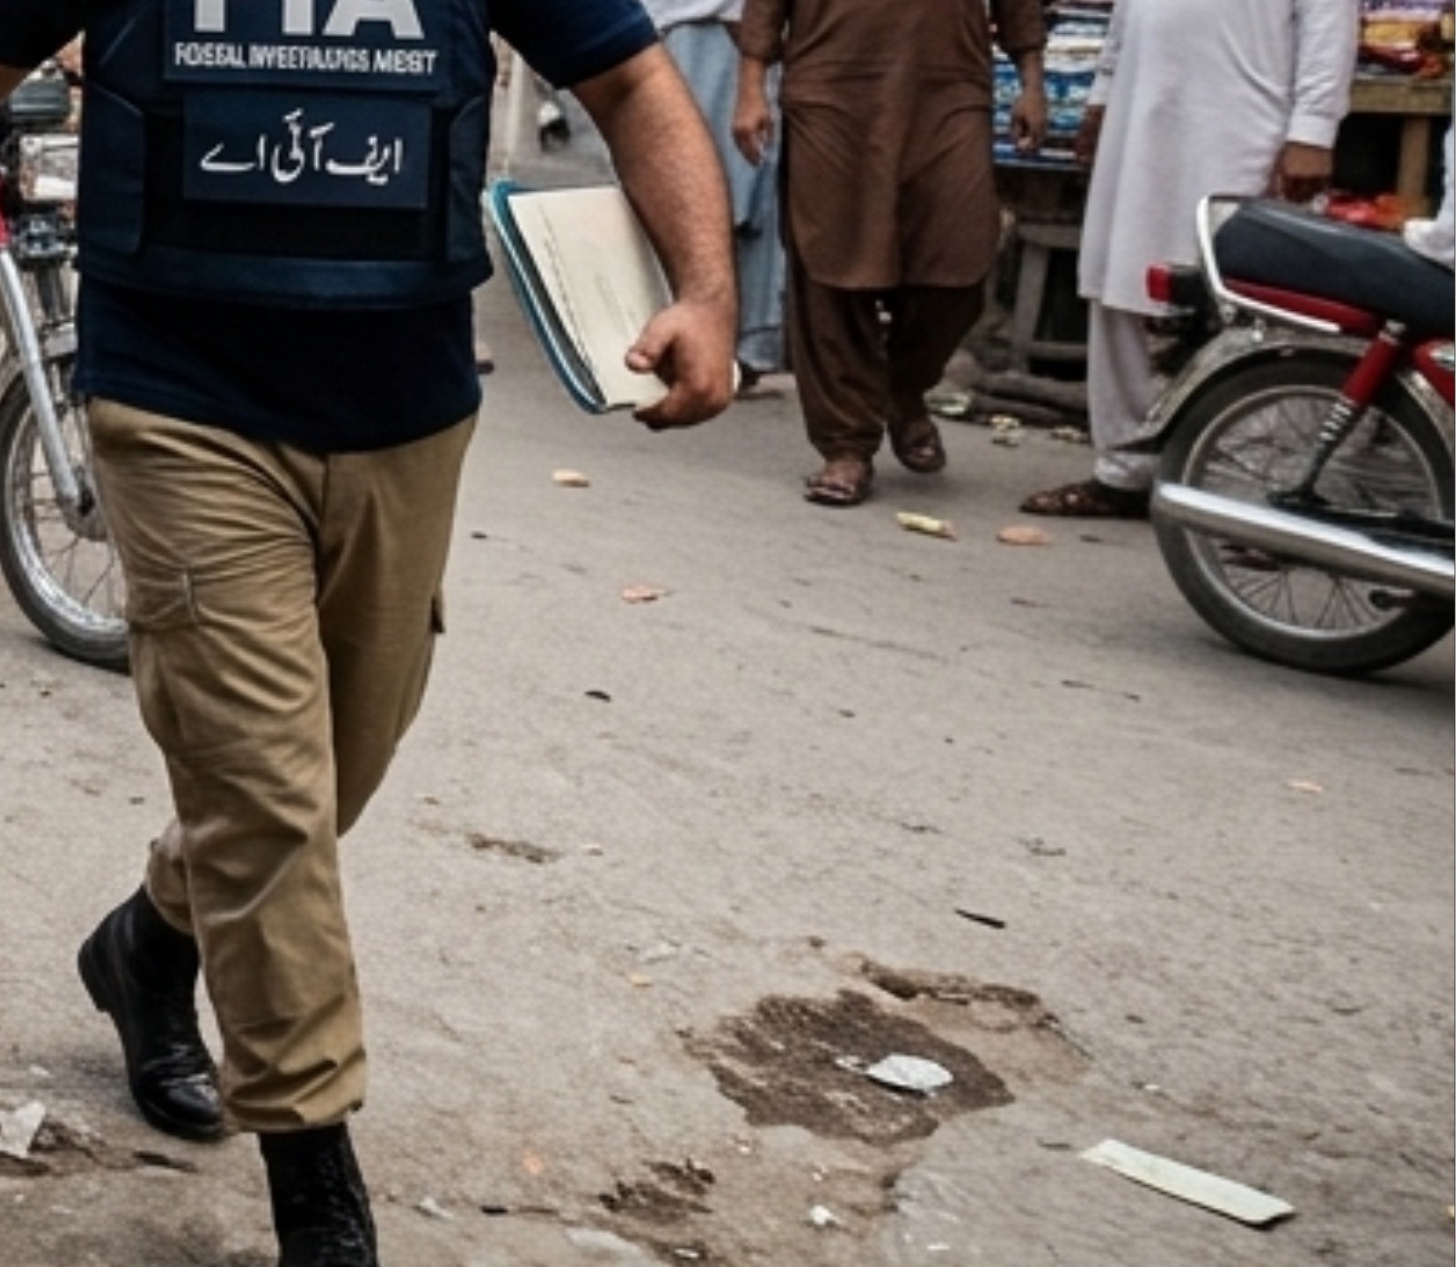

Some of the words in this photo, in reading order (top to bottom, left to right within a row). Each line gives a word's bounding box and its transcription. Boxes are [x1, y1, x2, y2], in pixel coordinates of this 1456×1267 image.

[200, 134, 266, 172] اے
[271, 108, 335, 184] آئی
[325, 134, 403, 185] ایف
